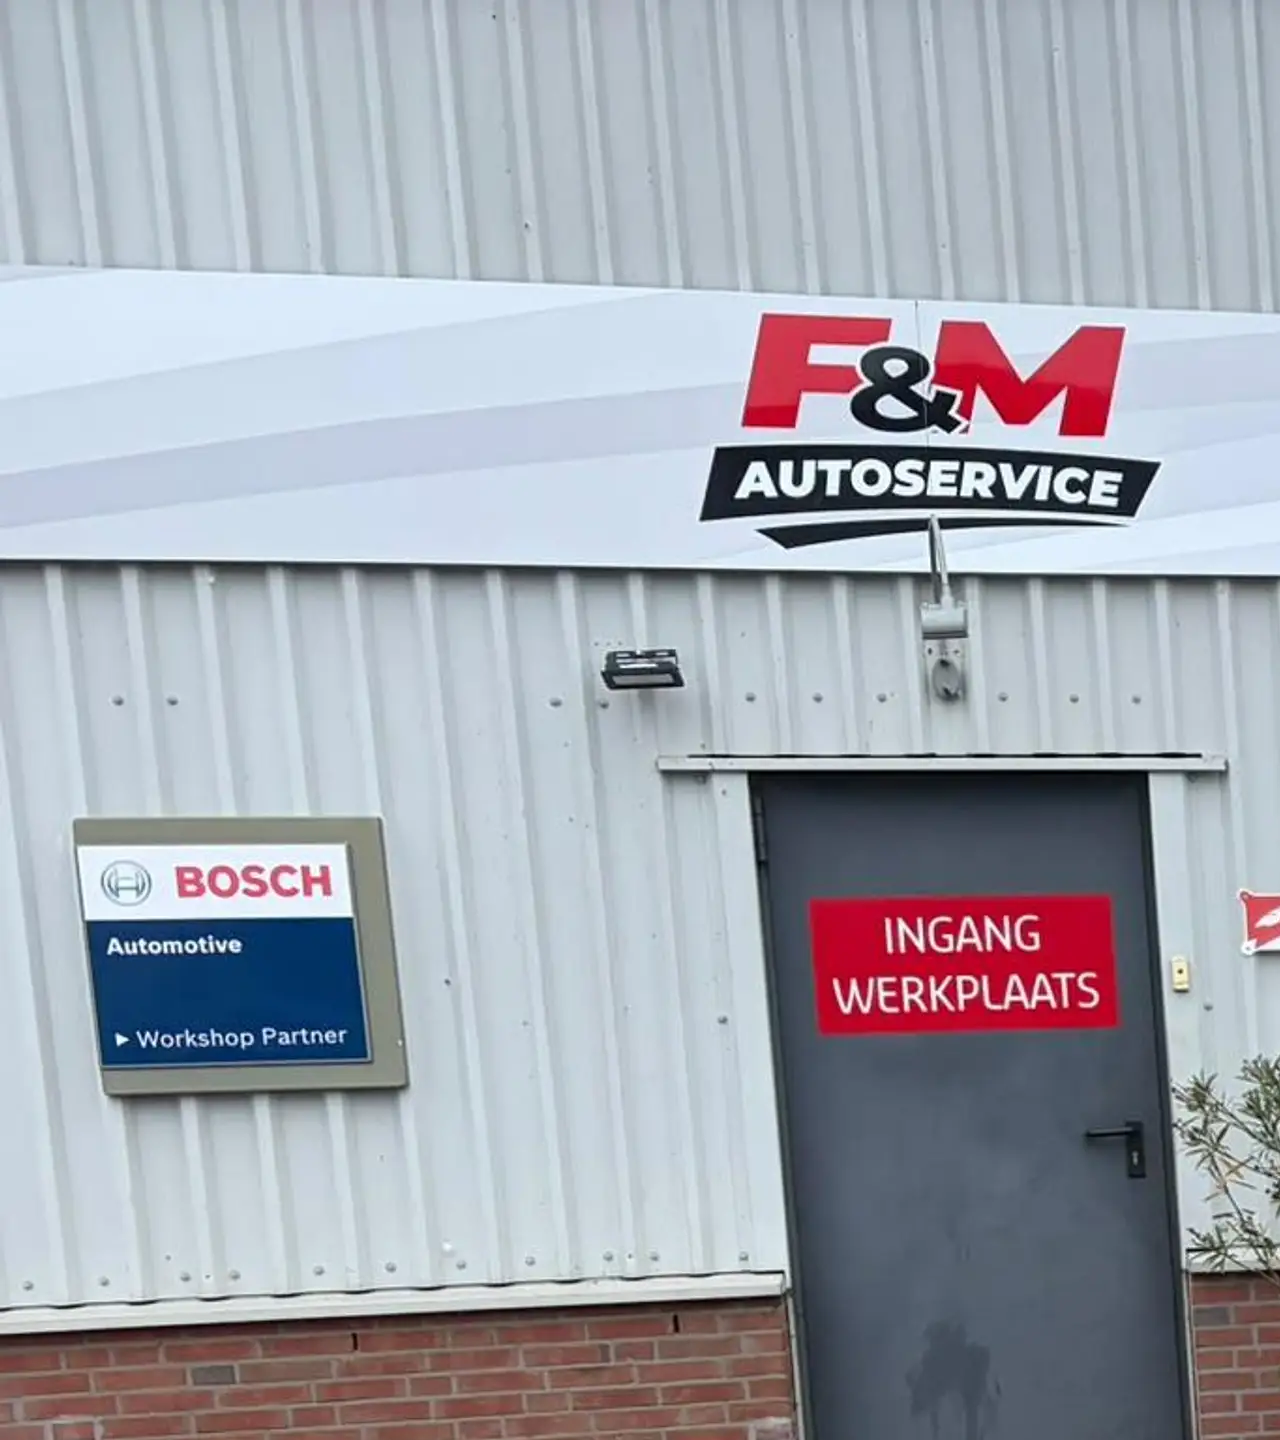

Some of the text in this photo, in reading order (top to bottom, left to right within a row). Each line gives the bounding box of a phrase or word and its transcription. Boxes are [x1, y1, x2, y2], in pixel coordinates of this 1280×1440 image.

[741, 313, 1126, 437] F&M
[734, 459, 1124, 508] AUTOSERVICE
[174, 864, 333, 899] BOSCH
[106, 935, 243, 956] Automotive
[884, 914, 1042, 954] INGANG
[832, 971, 1101, 1015] WERKPLAATS
[136, 1026, 348, 1051] Workshop Partner
